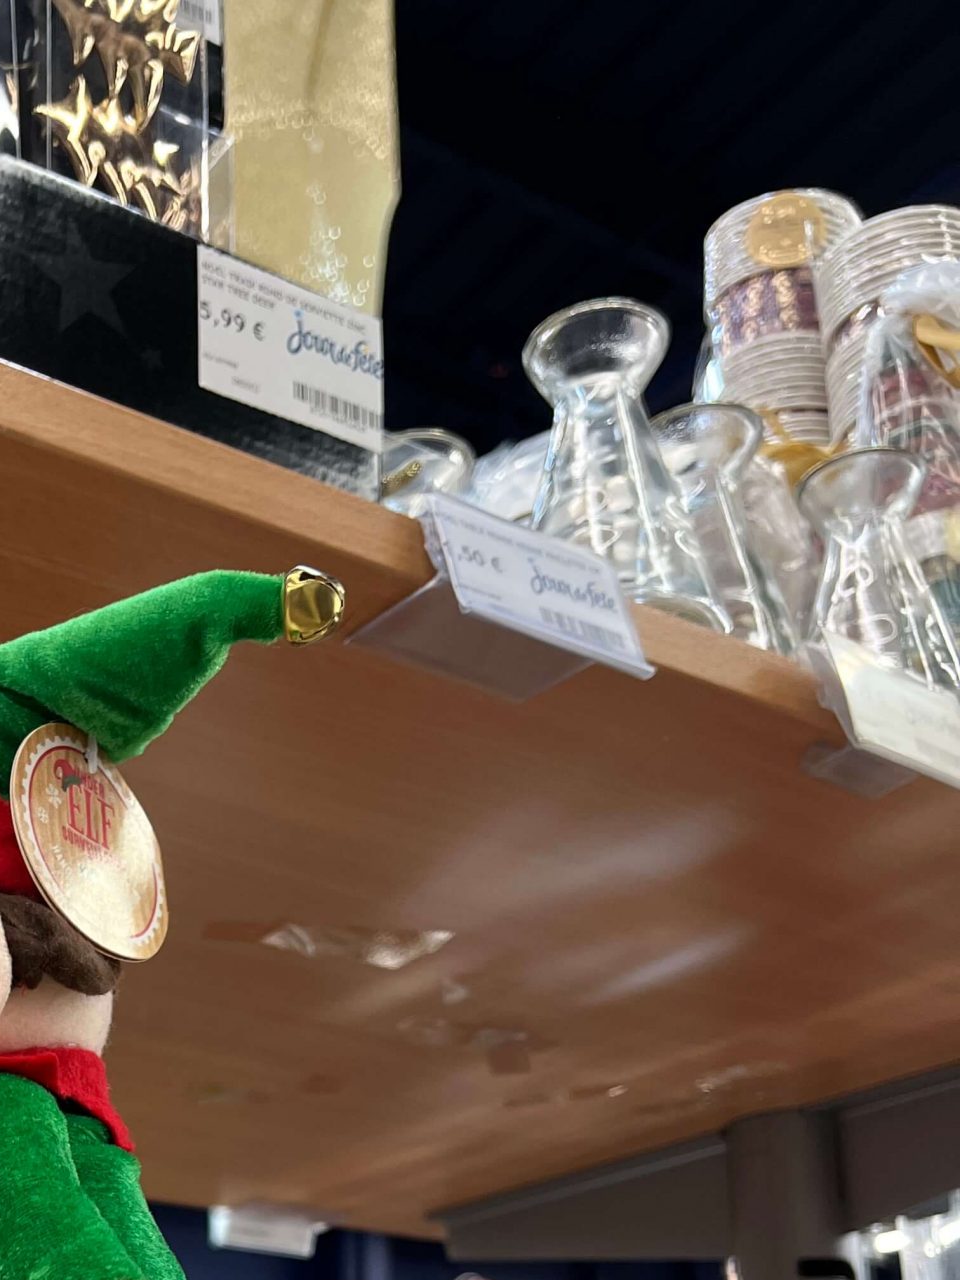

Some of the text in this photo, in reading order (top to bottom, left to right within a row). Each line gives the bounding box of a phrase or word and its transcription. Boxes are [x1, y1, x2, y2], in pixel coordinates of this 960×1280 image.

[200, 301, 266, 342] 5,99 €
[66, 784, 116, 851] ELF
